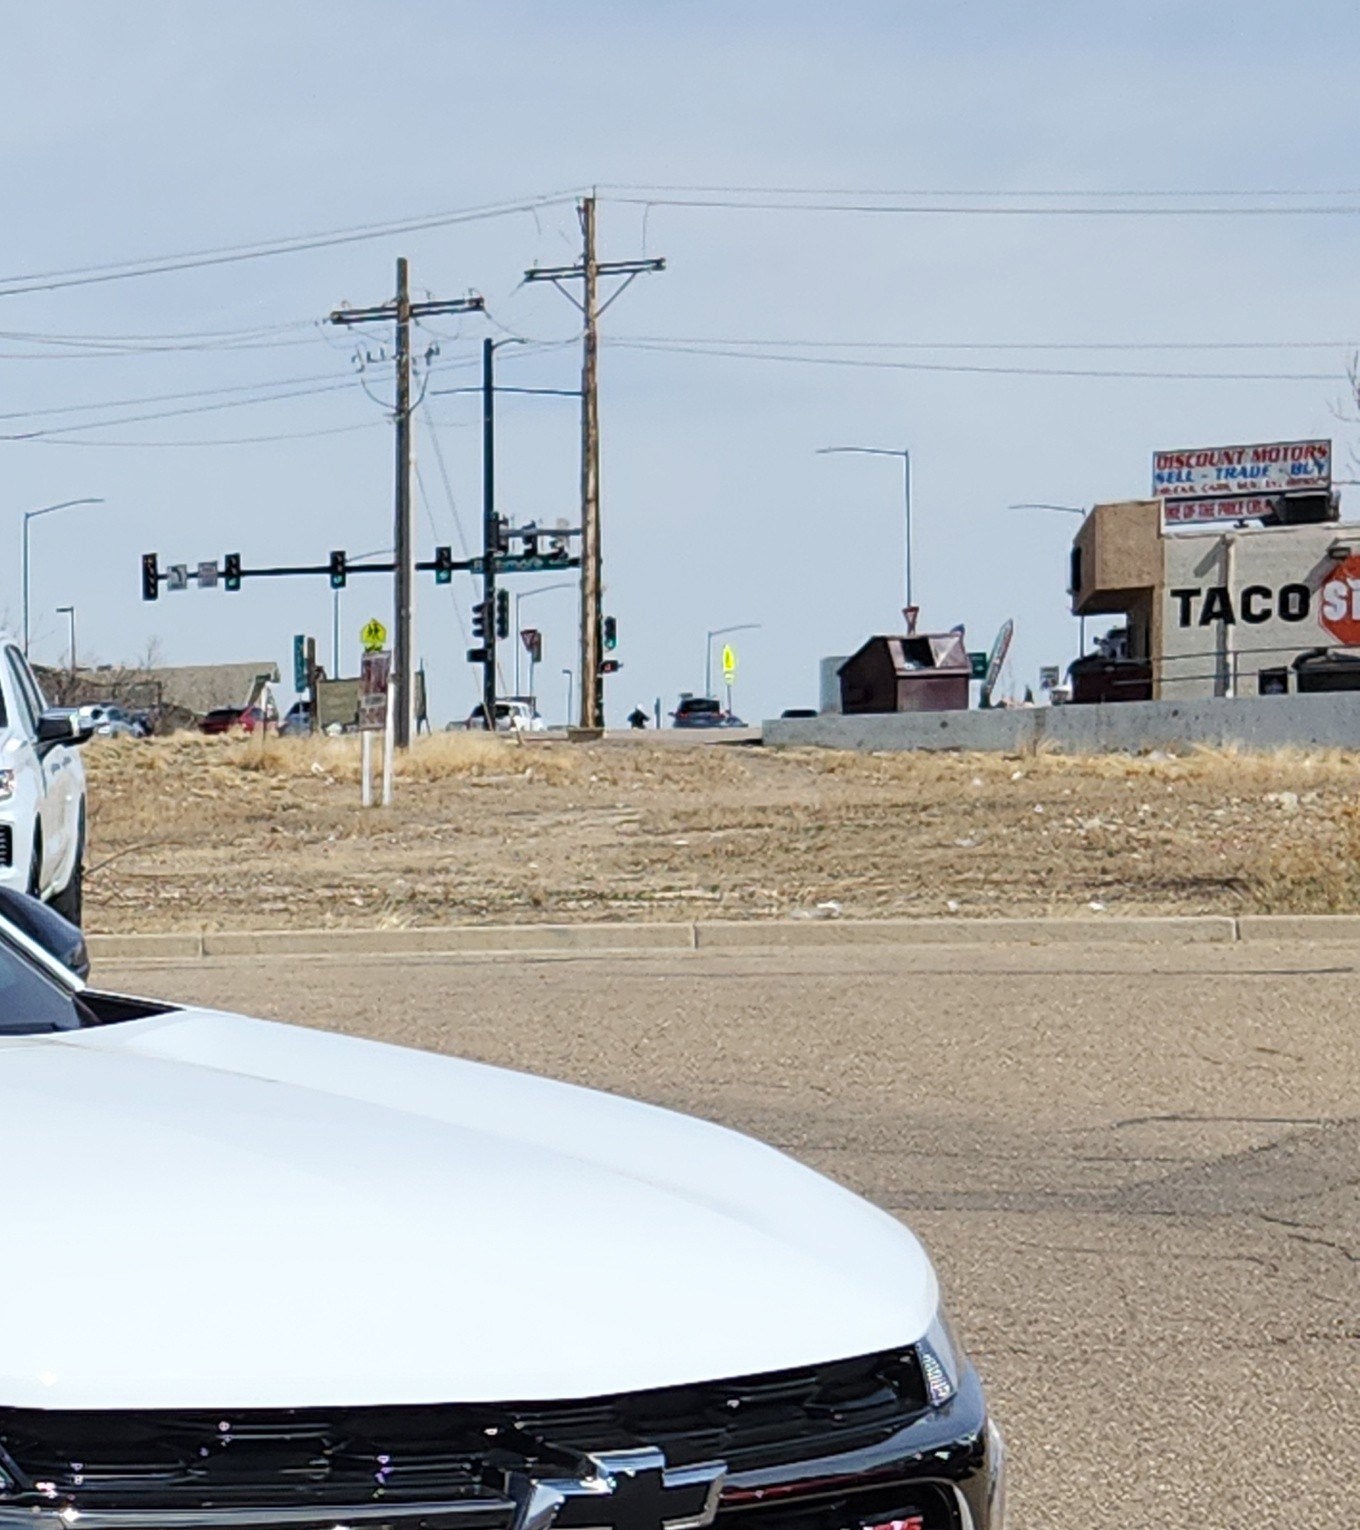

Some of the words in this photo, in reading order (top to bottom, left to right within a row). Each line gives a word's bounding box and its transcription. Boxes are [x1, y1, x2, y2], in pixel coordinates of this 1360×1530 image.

[1156, 449, 1246, 470] DISCOUNT
[1252, 444, 1328, 464] MOTORS
[1154, 470, 1194, 484] SELL
[1215, 464, 1272, 481] TRADE
[1290, 460, 1326, 476] BUY
[1170, 583, 1311, 628] TACO
